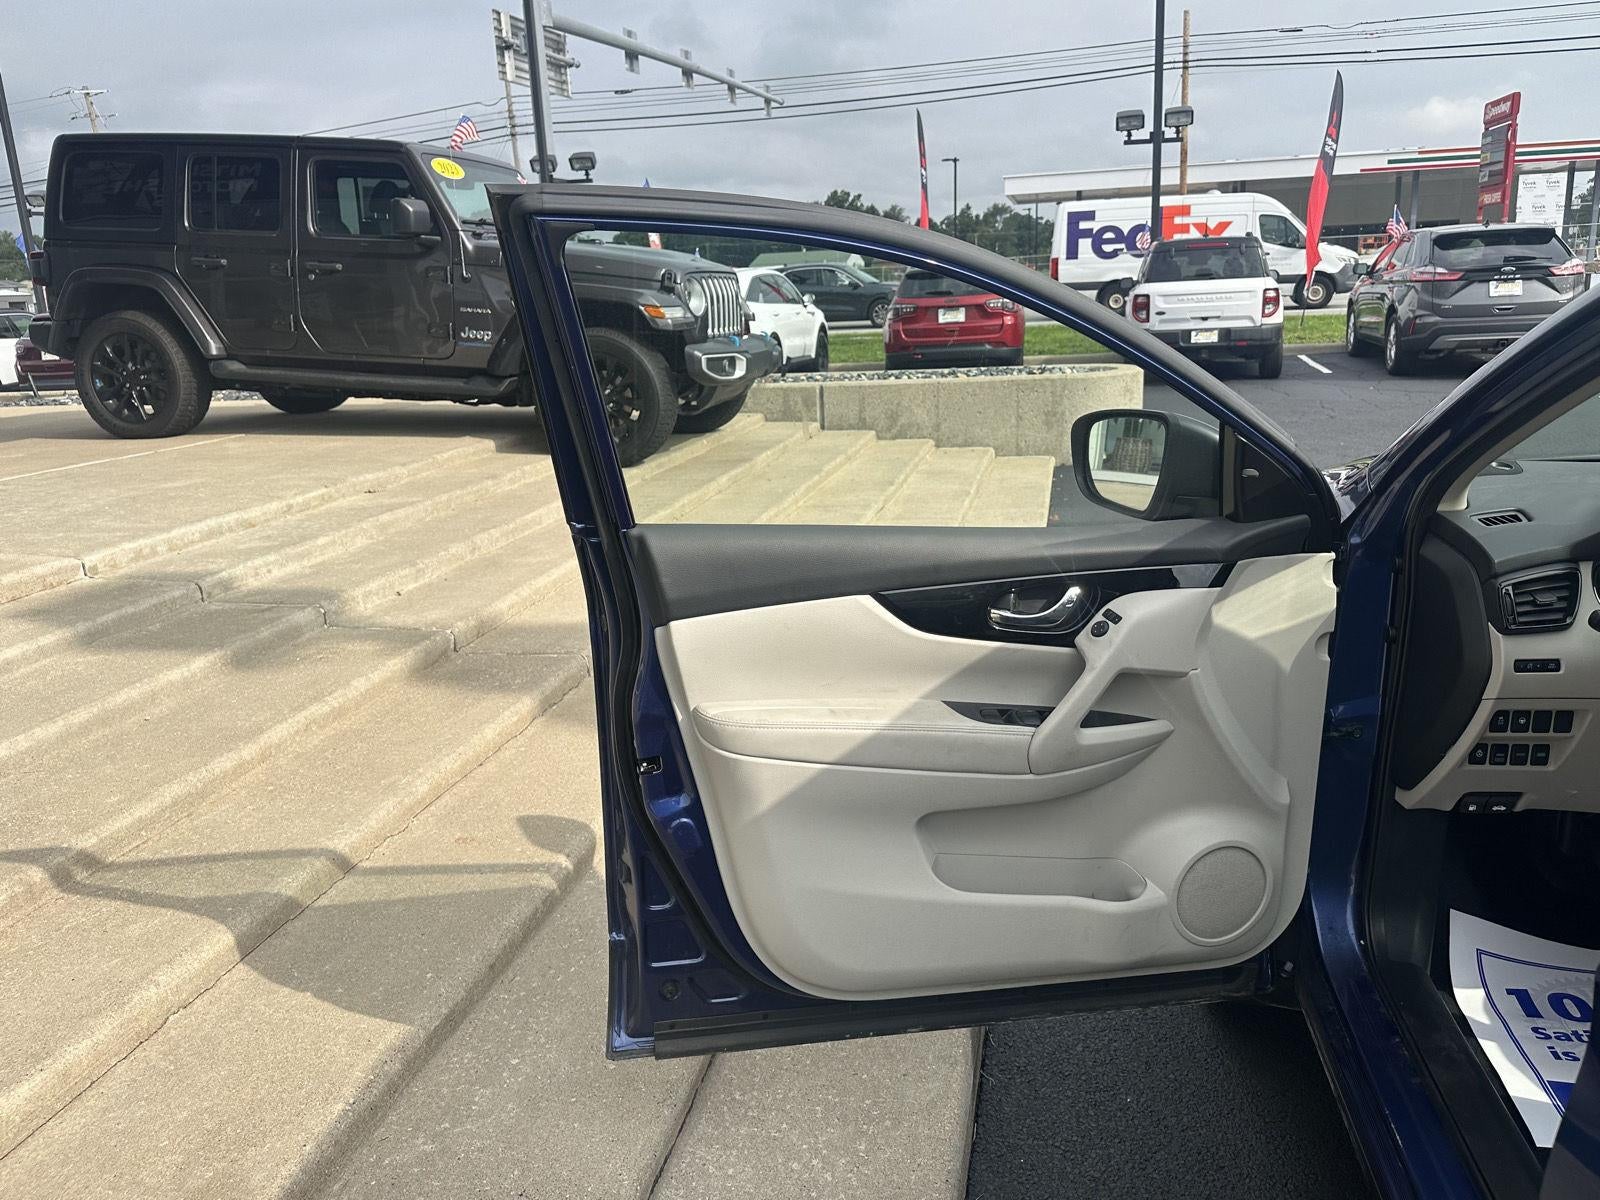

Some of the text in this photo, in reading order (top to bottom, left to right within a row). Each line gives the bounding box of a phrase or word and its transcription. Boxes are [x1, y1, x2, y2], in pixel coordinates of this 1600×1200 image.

[1486, 101, 1512, 119] Speedway
[460, 326, 492, 342] Jeep
[1547, 1046, 1581, 1062] is
